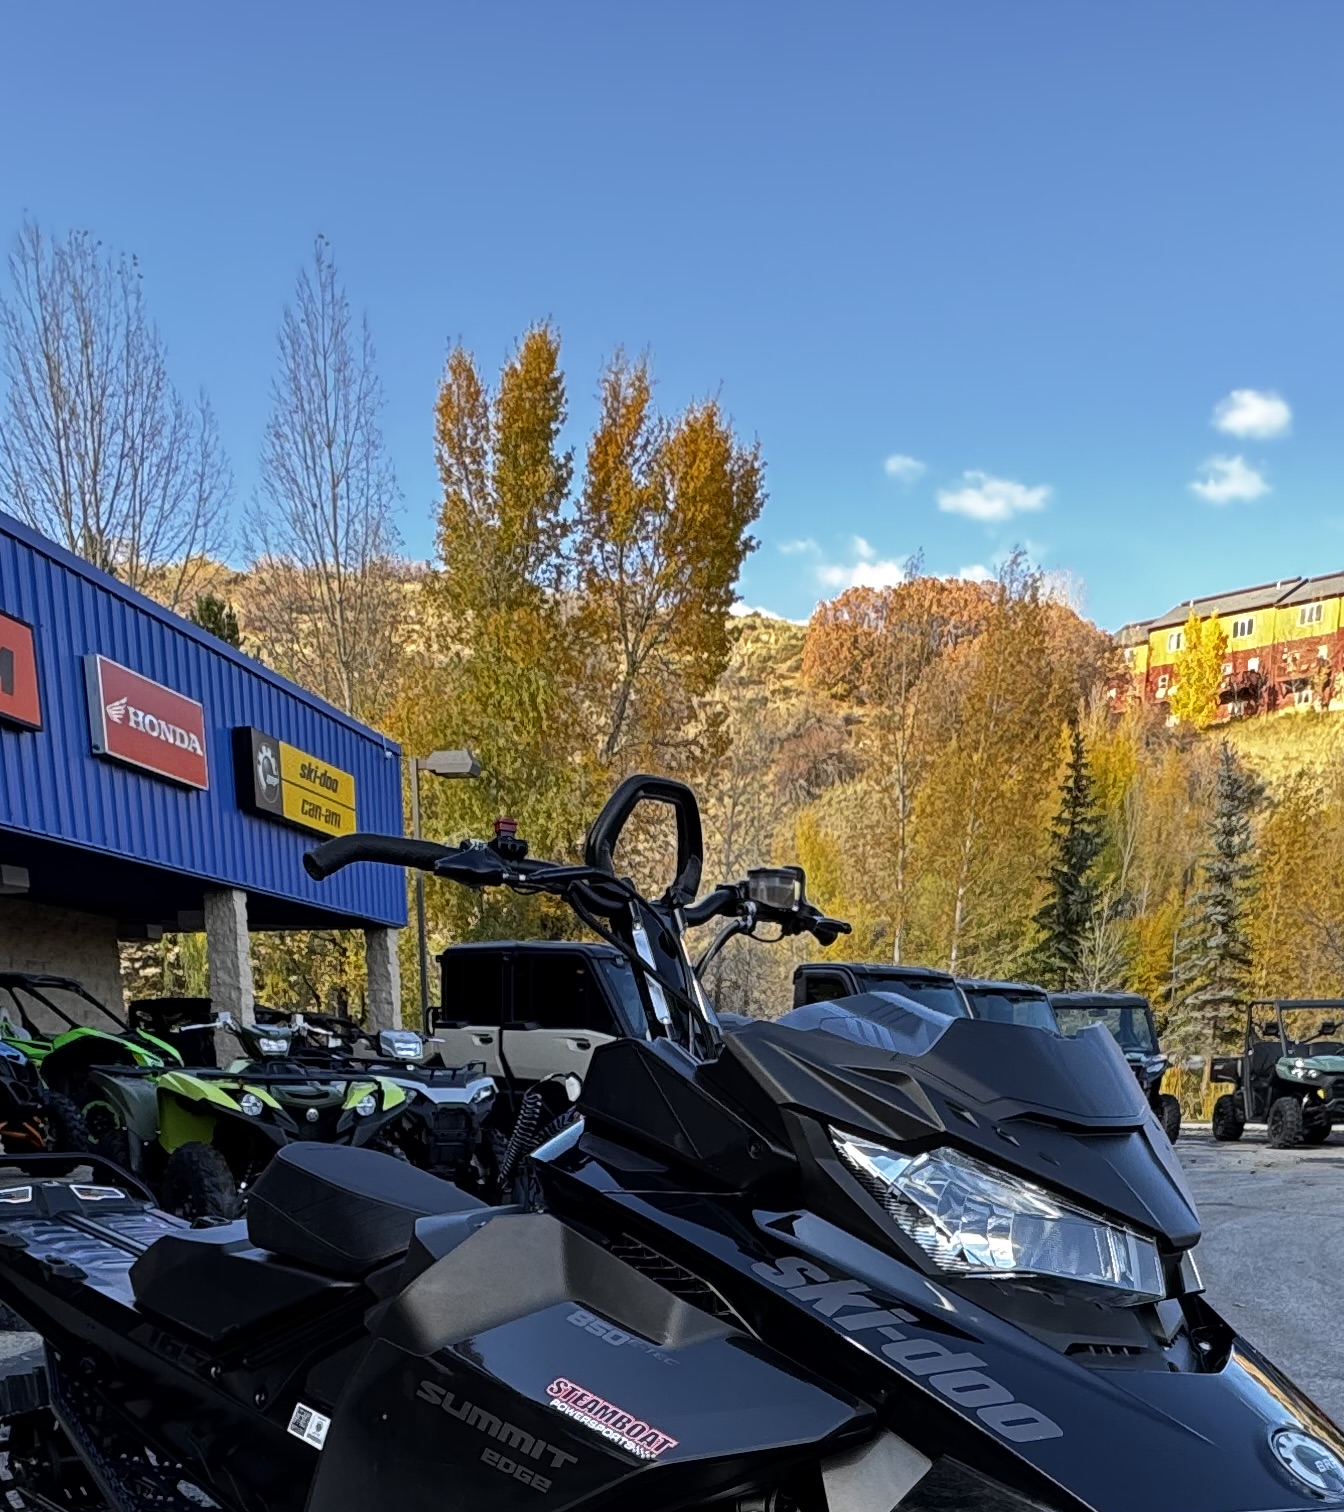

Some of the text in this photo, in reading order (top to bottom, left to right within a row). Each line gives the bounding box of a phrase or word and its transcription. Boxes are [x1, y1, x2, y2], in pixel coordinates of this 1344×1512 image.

[127, 706, 204, 756] HONDA
[299, 762, 339, 793] ski-doo
[301, 799, 341, 828] can-am
[566, 1310, 631, 1347] 850
[416, 1380, 578, 1469] SUMMIT
[546, 1378, 679, 1455] STEAMBOAT
[550, 1399, 636, 1452] POWERSPORTS
[479, 1447, 552, 1494] EDGE
